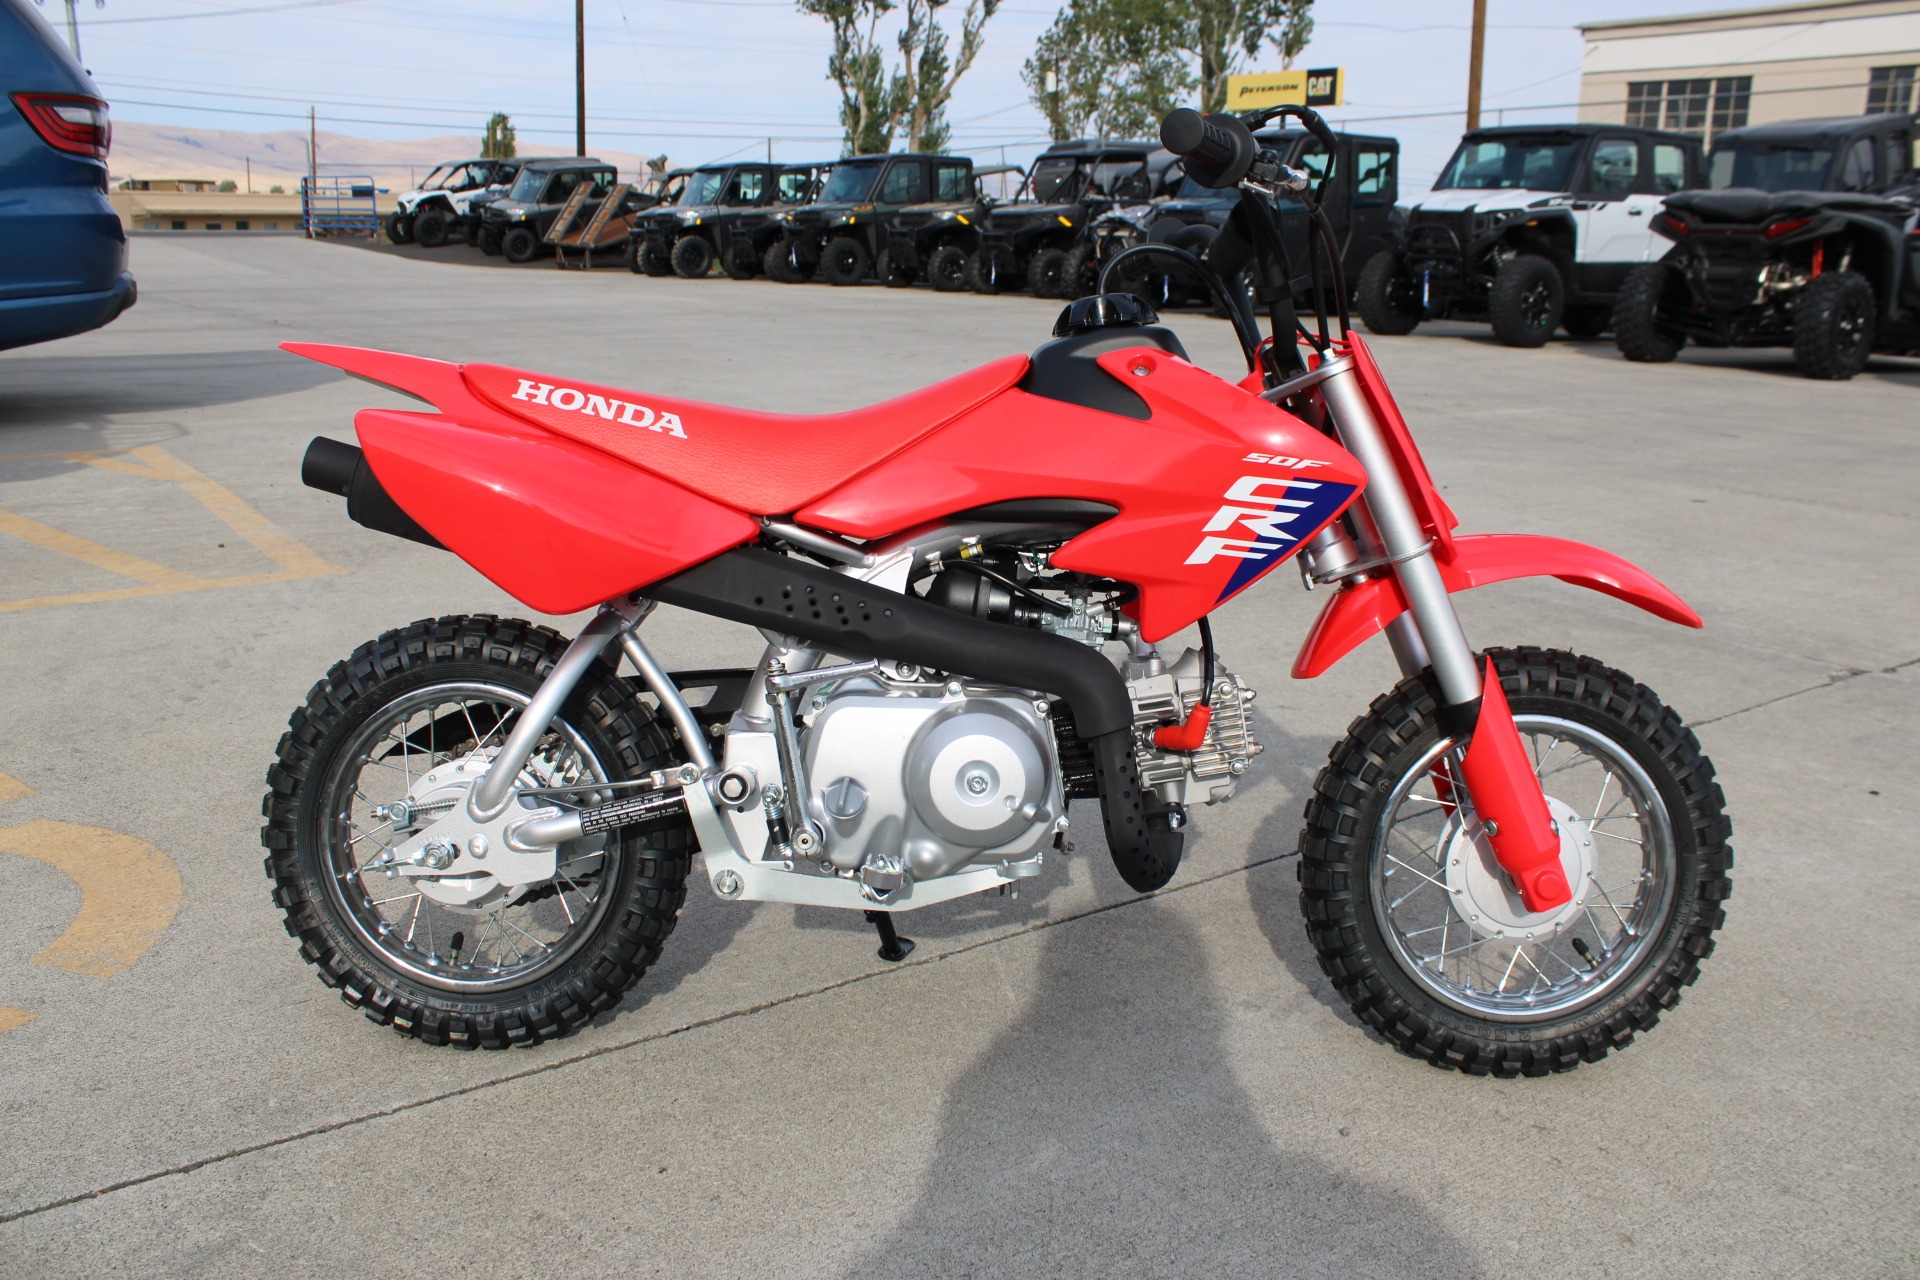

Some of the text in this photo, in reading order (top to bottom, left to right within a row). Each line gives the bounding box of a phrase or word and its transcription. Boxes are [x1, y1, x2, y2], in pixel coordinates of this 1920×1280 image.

[1239, 83, 1299, 97] PETERSON
[1308, 76, 1333, 97] CAT
[511, 378, 688, 440] HONDA
[1241, 452, 1333, 470] 50F
[1183, 475, 1323, 565] CRF
[1438, 1012, 1531, 1041] 2.50-10
